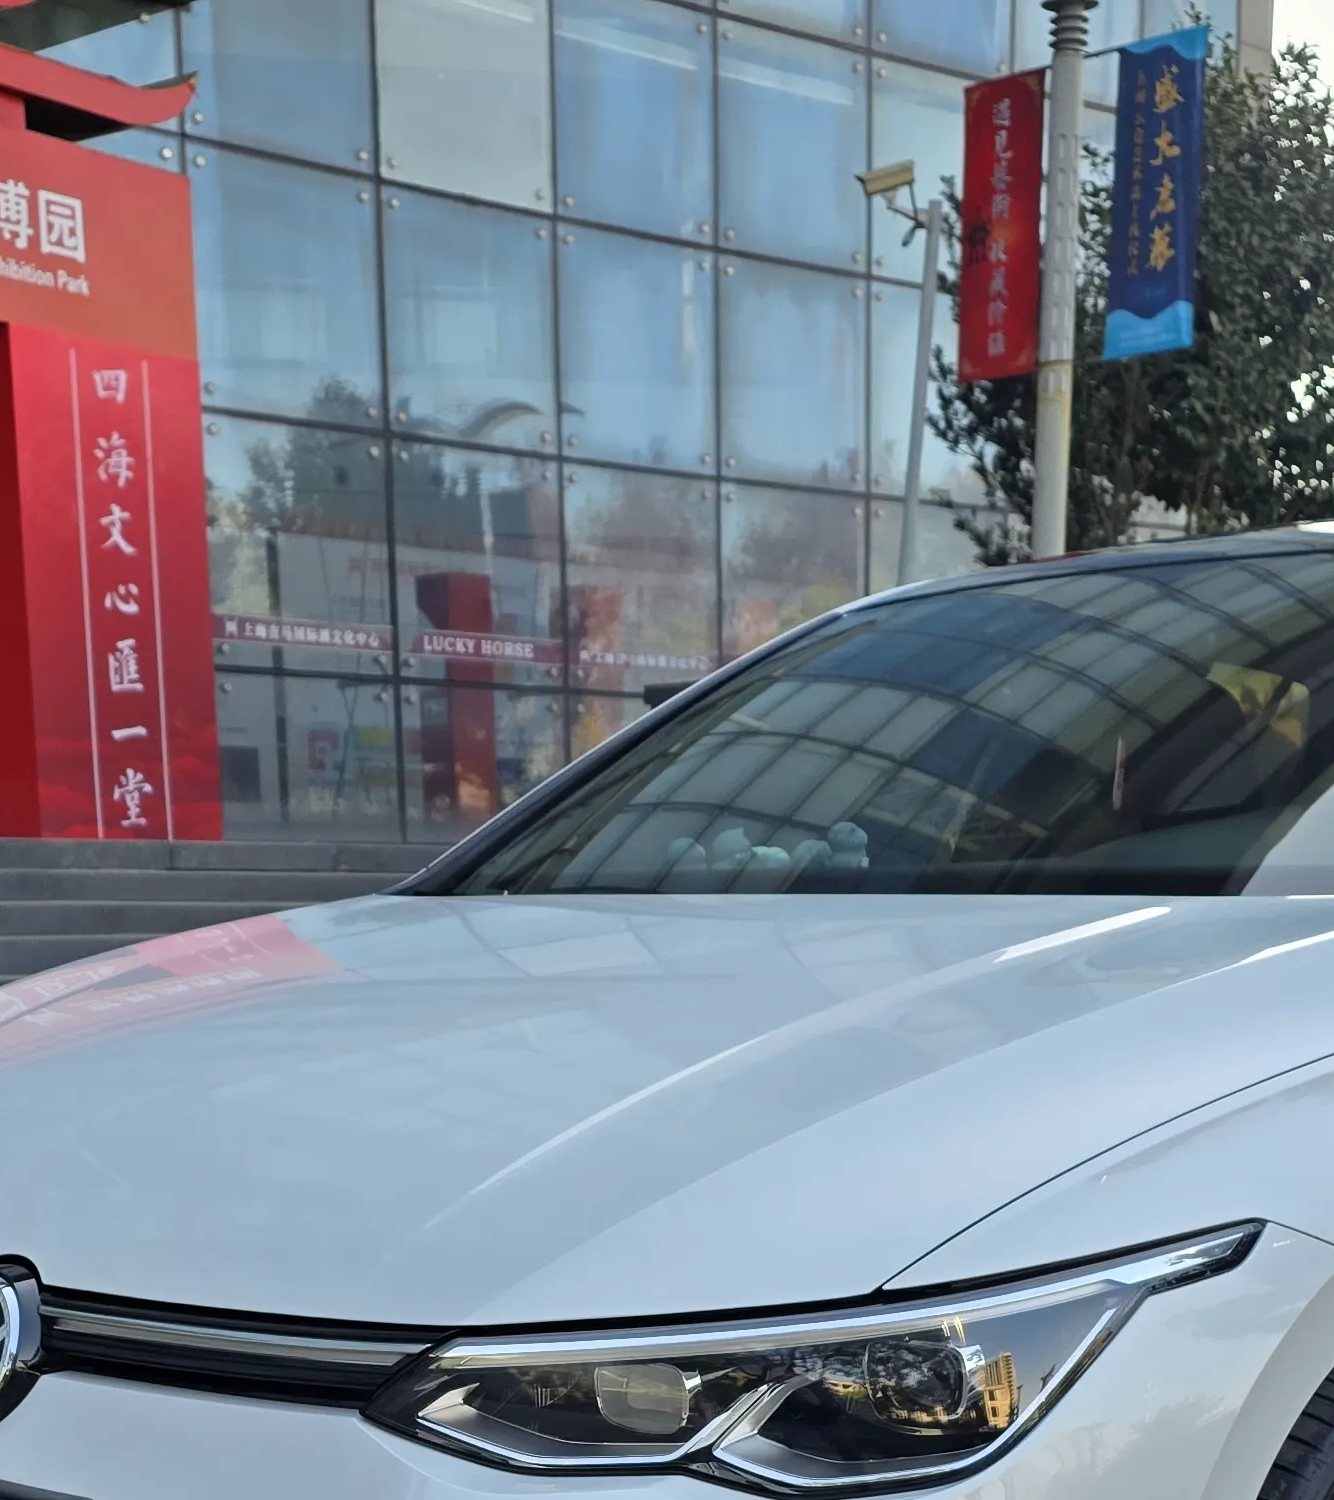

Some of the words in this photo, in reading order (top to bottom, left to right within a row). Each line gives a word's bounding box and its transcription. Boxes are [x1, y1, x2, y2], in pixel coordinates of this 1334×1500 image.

[57, 269, 90, 297] Park
[423, 635, 474, 654] LUCKY
[481, 640, 534, 658] HORSE
